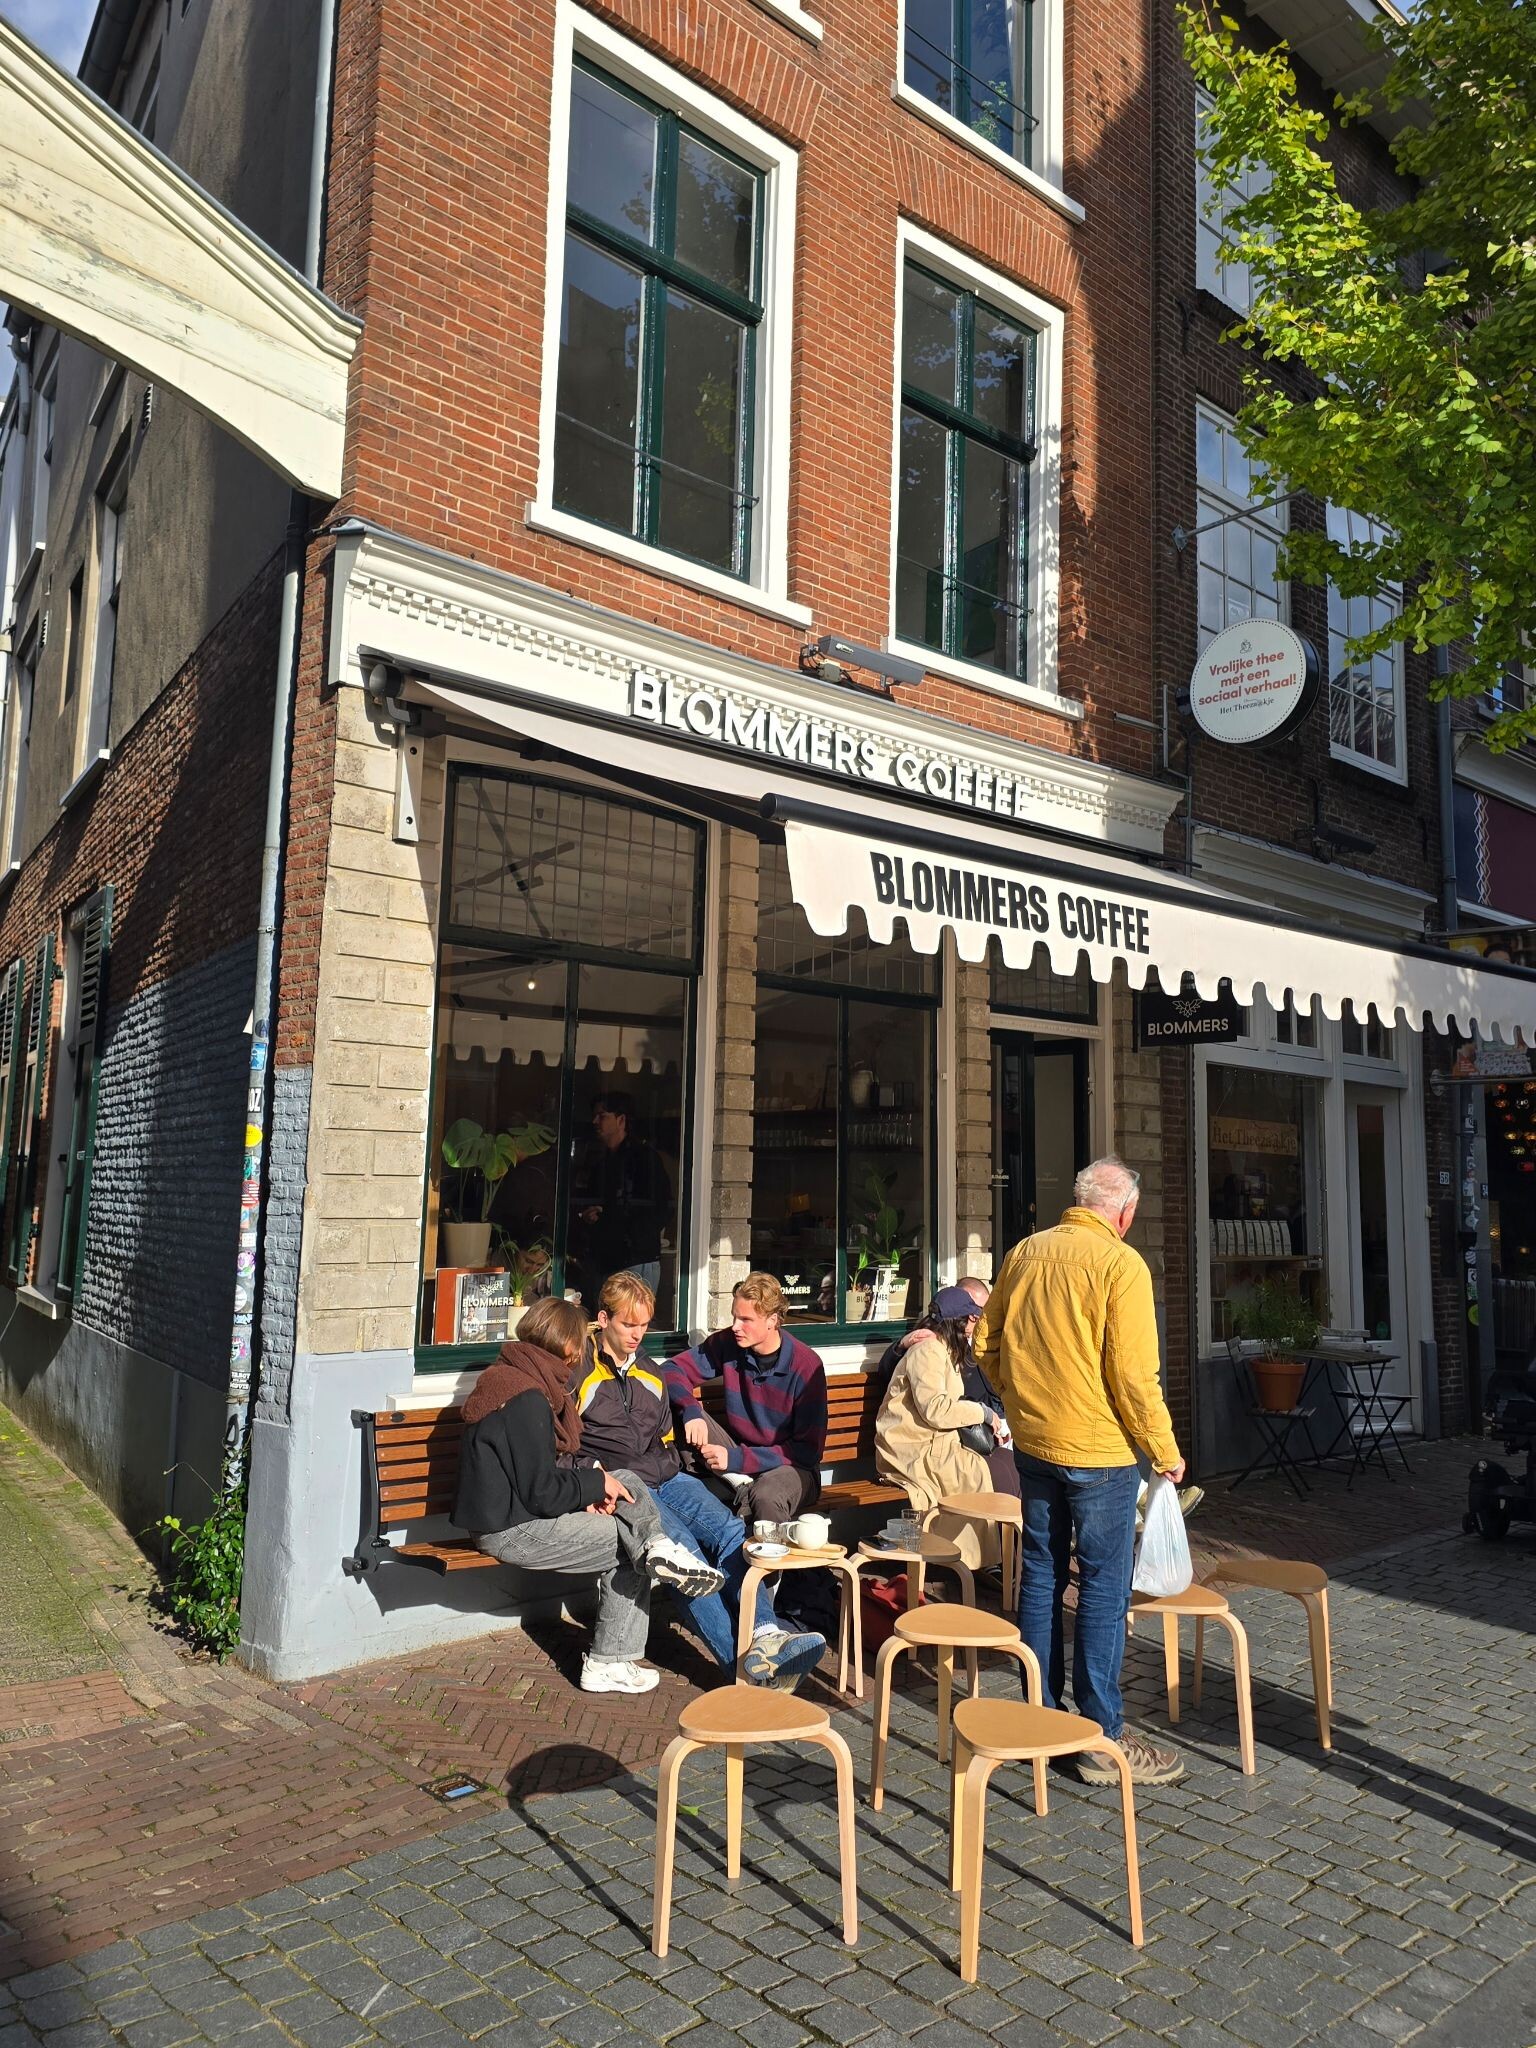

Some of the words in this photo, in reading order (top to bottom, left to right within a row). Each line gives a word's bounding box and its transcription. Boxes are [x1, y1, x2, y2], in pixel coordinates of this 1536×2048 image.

[1209, 658, 1254, 677] Vrolijke
[1255, 651, 1285, 666] thee
[1198, 686, 1242, 706] sociaal
[1244, 673, 1297, 695] verhaal!
[1220, 672, 1244, 688] met
[1247, 669, 1270, 681] een
[1220, 707, 1232, 715] Het
[632, 670, 880, 780] BLOMMERS
[893, 751, 1031, 816] COFFEE
[870, 851, 1050, 934] BLOMMERS
[1057, 891, 1150, 955] COFFEE
[1147, 1018, 1229, 1036] BLOMMERS
[780, 1286, 811, 1295] OMMERS
